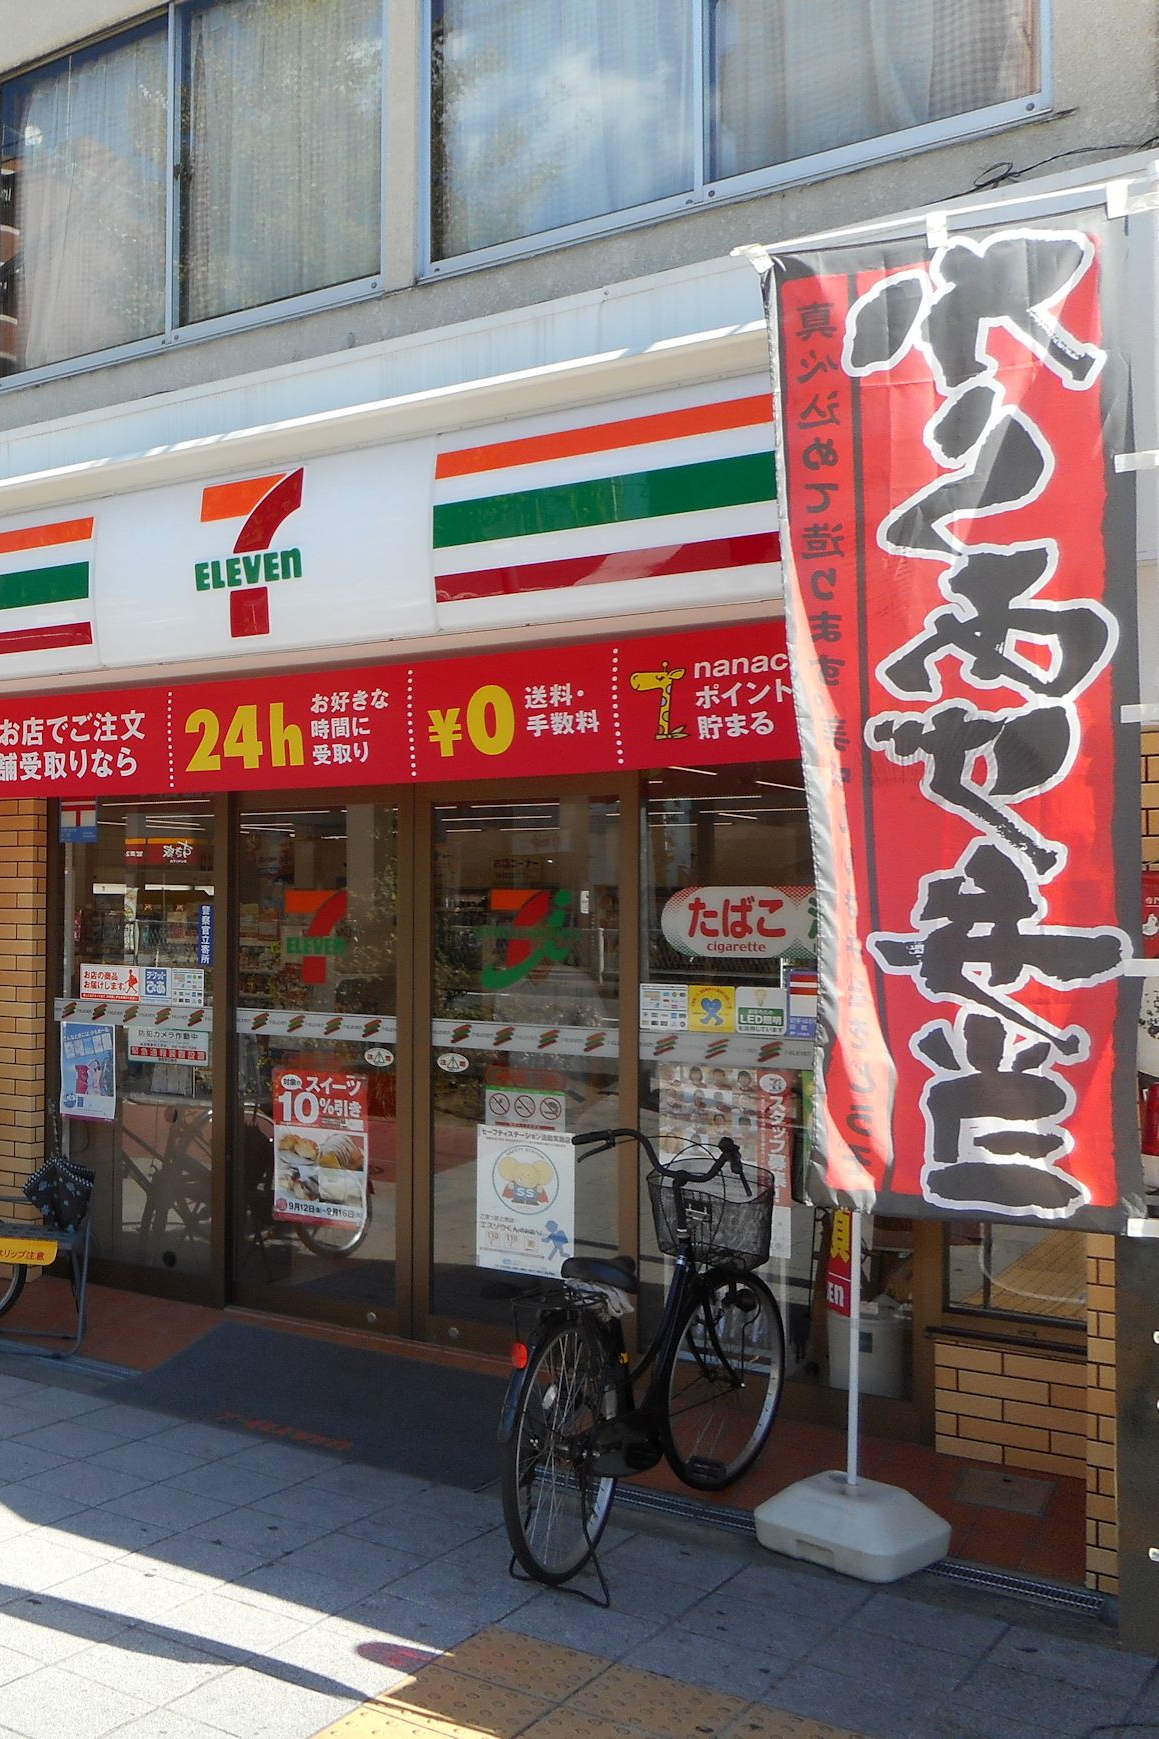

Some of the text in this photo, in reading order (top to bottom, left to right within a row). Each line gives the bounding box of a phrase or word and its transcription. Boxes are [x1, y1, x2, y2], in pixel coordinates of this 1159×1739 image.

[310, 688, 389, 714] お好きな
[310, 716, 371, 739] 時間に
[427, 684, 516, 757] ¥0
[526, 709, 600, 737] 手数料
[697, 713, 775, 740] 貯まる
[184, 702, 304, 772] 24h
[312, 742, 370, 766] 受取り
[688, 895, 786, 939] たばこ
[201, 905, 211, 965] 警察官立寄所
[707, 942, 767, 953] cigarette
[83, 971, 118, 980] お店の商品
[146, 980, 166, 994] ぴあ
[740, 1014, 782, 1025] LED照明
[138, 1029, 198, 1040] 防犯カメラ作動中
[305, 1076, 362, 1096] スイーツ
